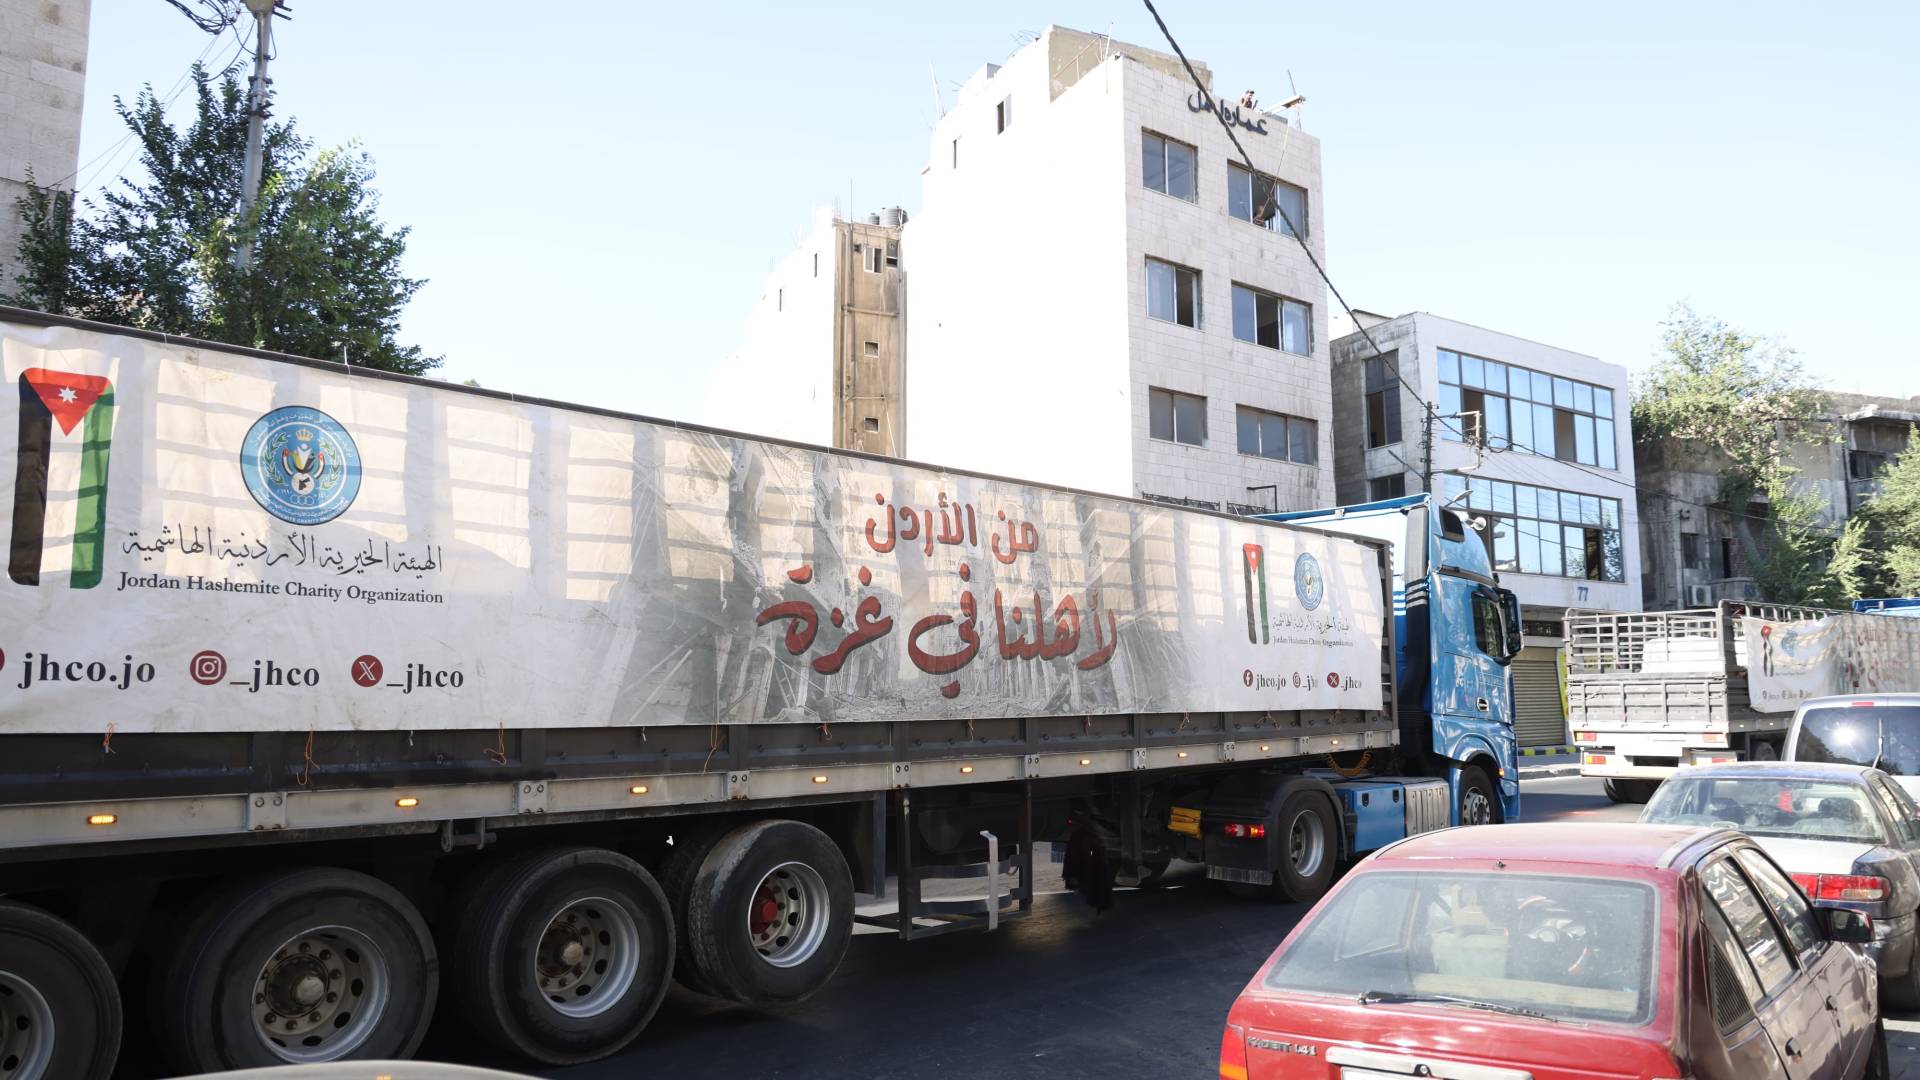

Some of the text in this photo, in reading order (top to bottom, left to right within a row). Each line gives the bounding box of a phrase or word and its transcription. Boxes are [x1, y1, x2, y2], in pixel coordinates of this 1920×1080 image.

[122, 522, 443, 580] الهيئة الخيرية الأردنية الهاشمية
[865, 491, 1040, 565] من الأردن
[117, 571, 444, 605] Jordan Hashemite Charity Organization
[1576, 586, 1589, 602] 77
[755, 564, 894, 676] غزة
[994, 588, 1118, 671] لأهلنا
[17, 652, 156, 690] jhco.jo
